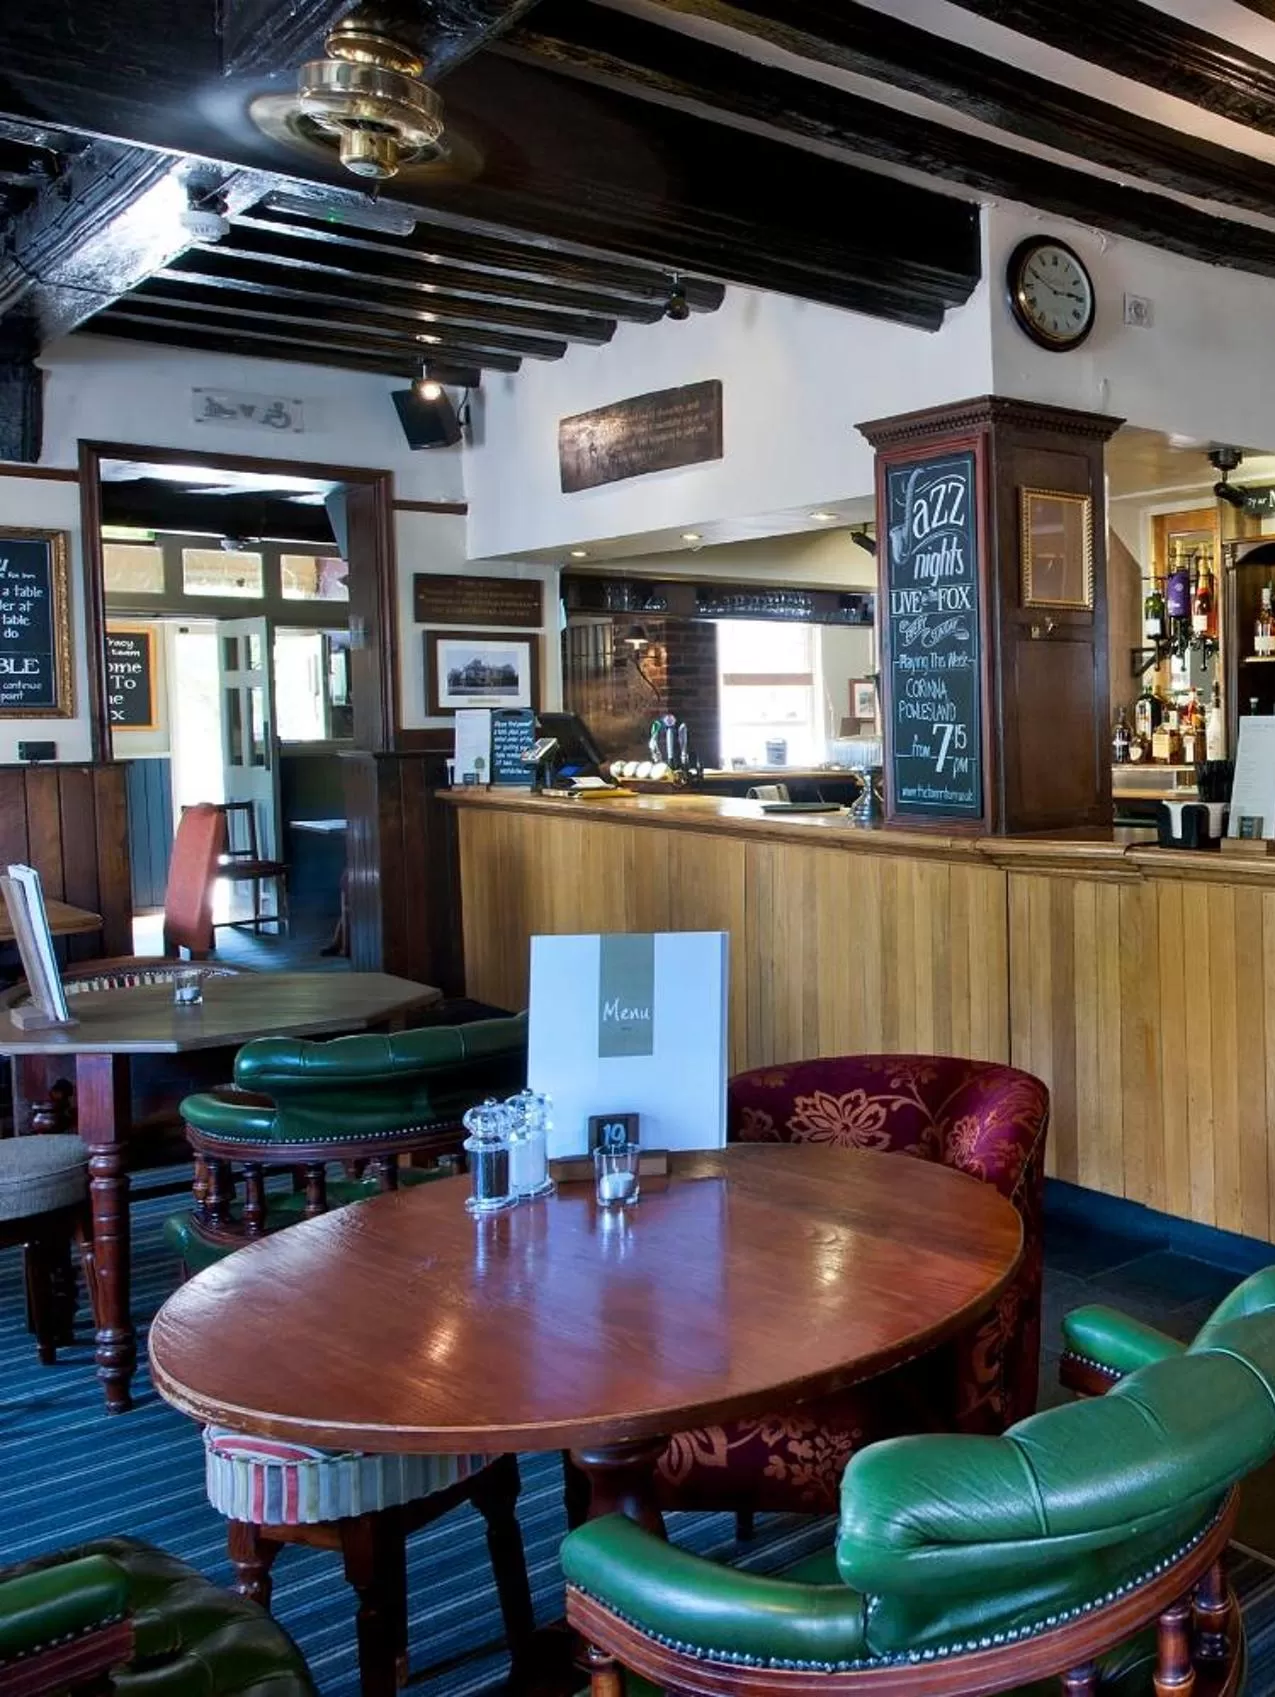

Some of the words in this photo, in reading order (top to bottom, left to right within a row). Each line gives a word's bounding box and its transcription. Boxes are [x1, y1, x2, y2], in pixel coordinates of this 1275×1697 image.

[914, 536, 964, 586] nights
[14, 585, 43, 598] table
[18, 601, 34, 612] at
[892, 591, 922, 614] LIVE
[938, 586, 971, 611] FOX
[3, 614, 31, 626] table
[3, 628, 19, 639] do
[106, 637, 134, 649] racy
[931, 653, 945, 667] This
[3, 681, 42, 690] continue
[110, 675, 136, 689] To
[603, 998, 650, 1021] Menu
[603, 1123, 626, 1146] 19
